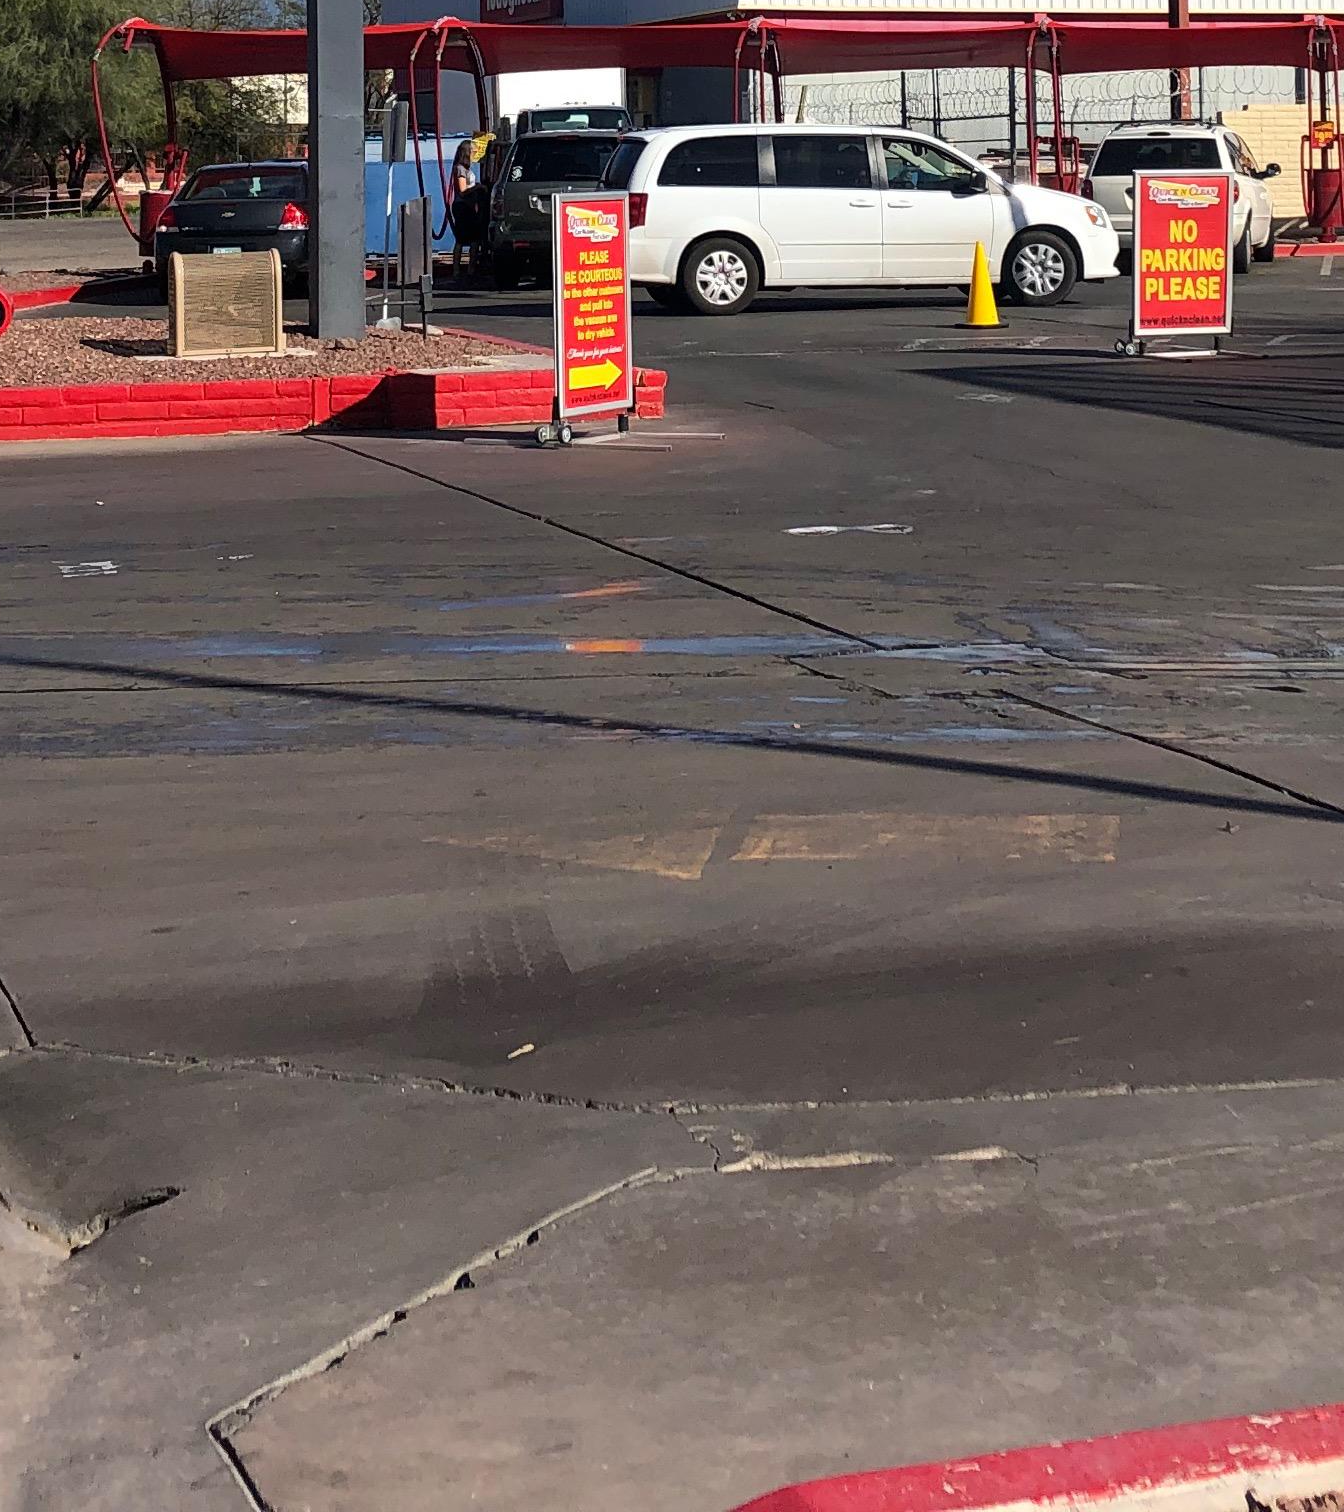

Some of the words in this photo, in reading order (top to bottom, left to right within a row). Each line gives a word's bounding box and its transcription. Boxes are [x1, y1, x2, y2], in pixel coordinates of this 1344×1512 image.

[1169, 219, 1198, 243] NO
[579, 250, 609, 265] PLEASE
[1141, 248, 1225, 273] PARKING
[564, 270, 577, 284] BE
[578, 268, 623, 283] COURTEOUS
[571, 288, 582, 298] the
[582, 287, 598, 297] other
[1145, 276, 1221, 302] PLEASE
